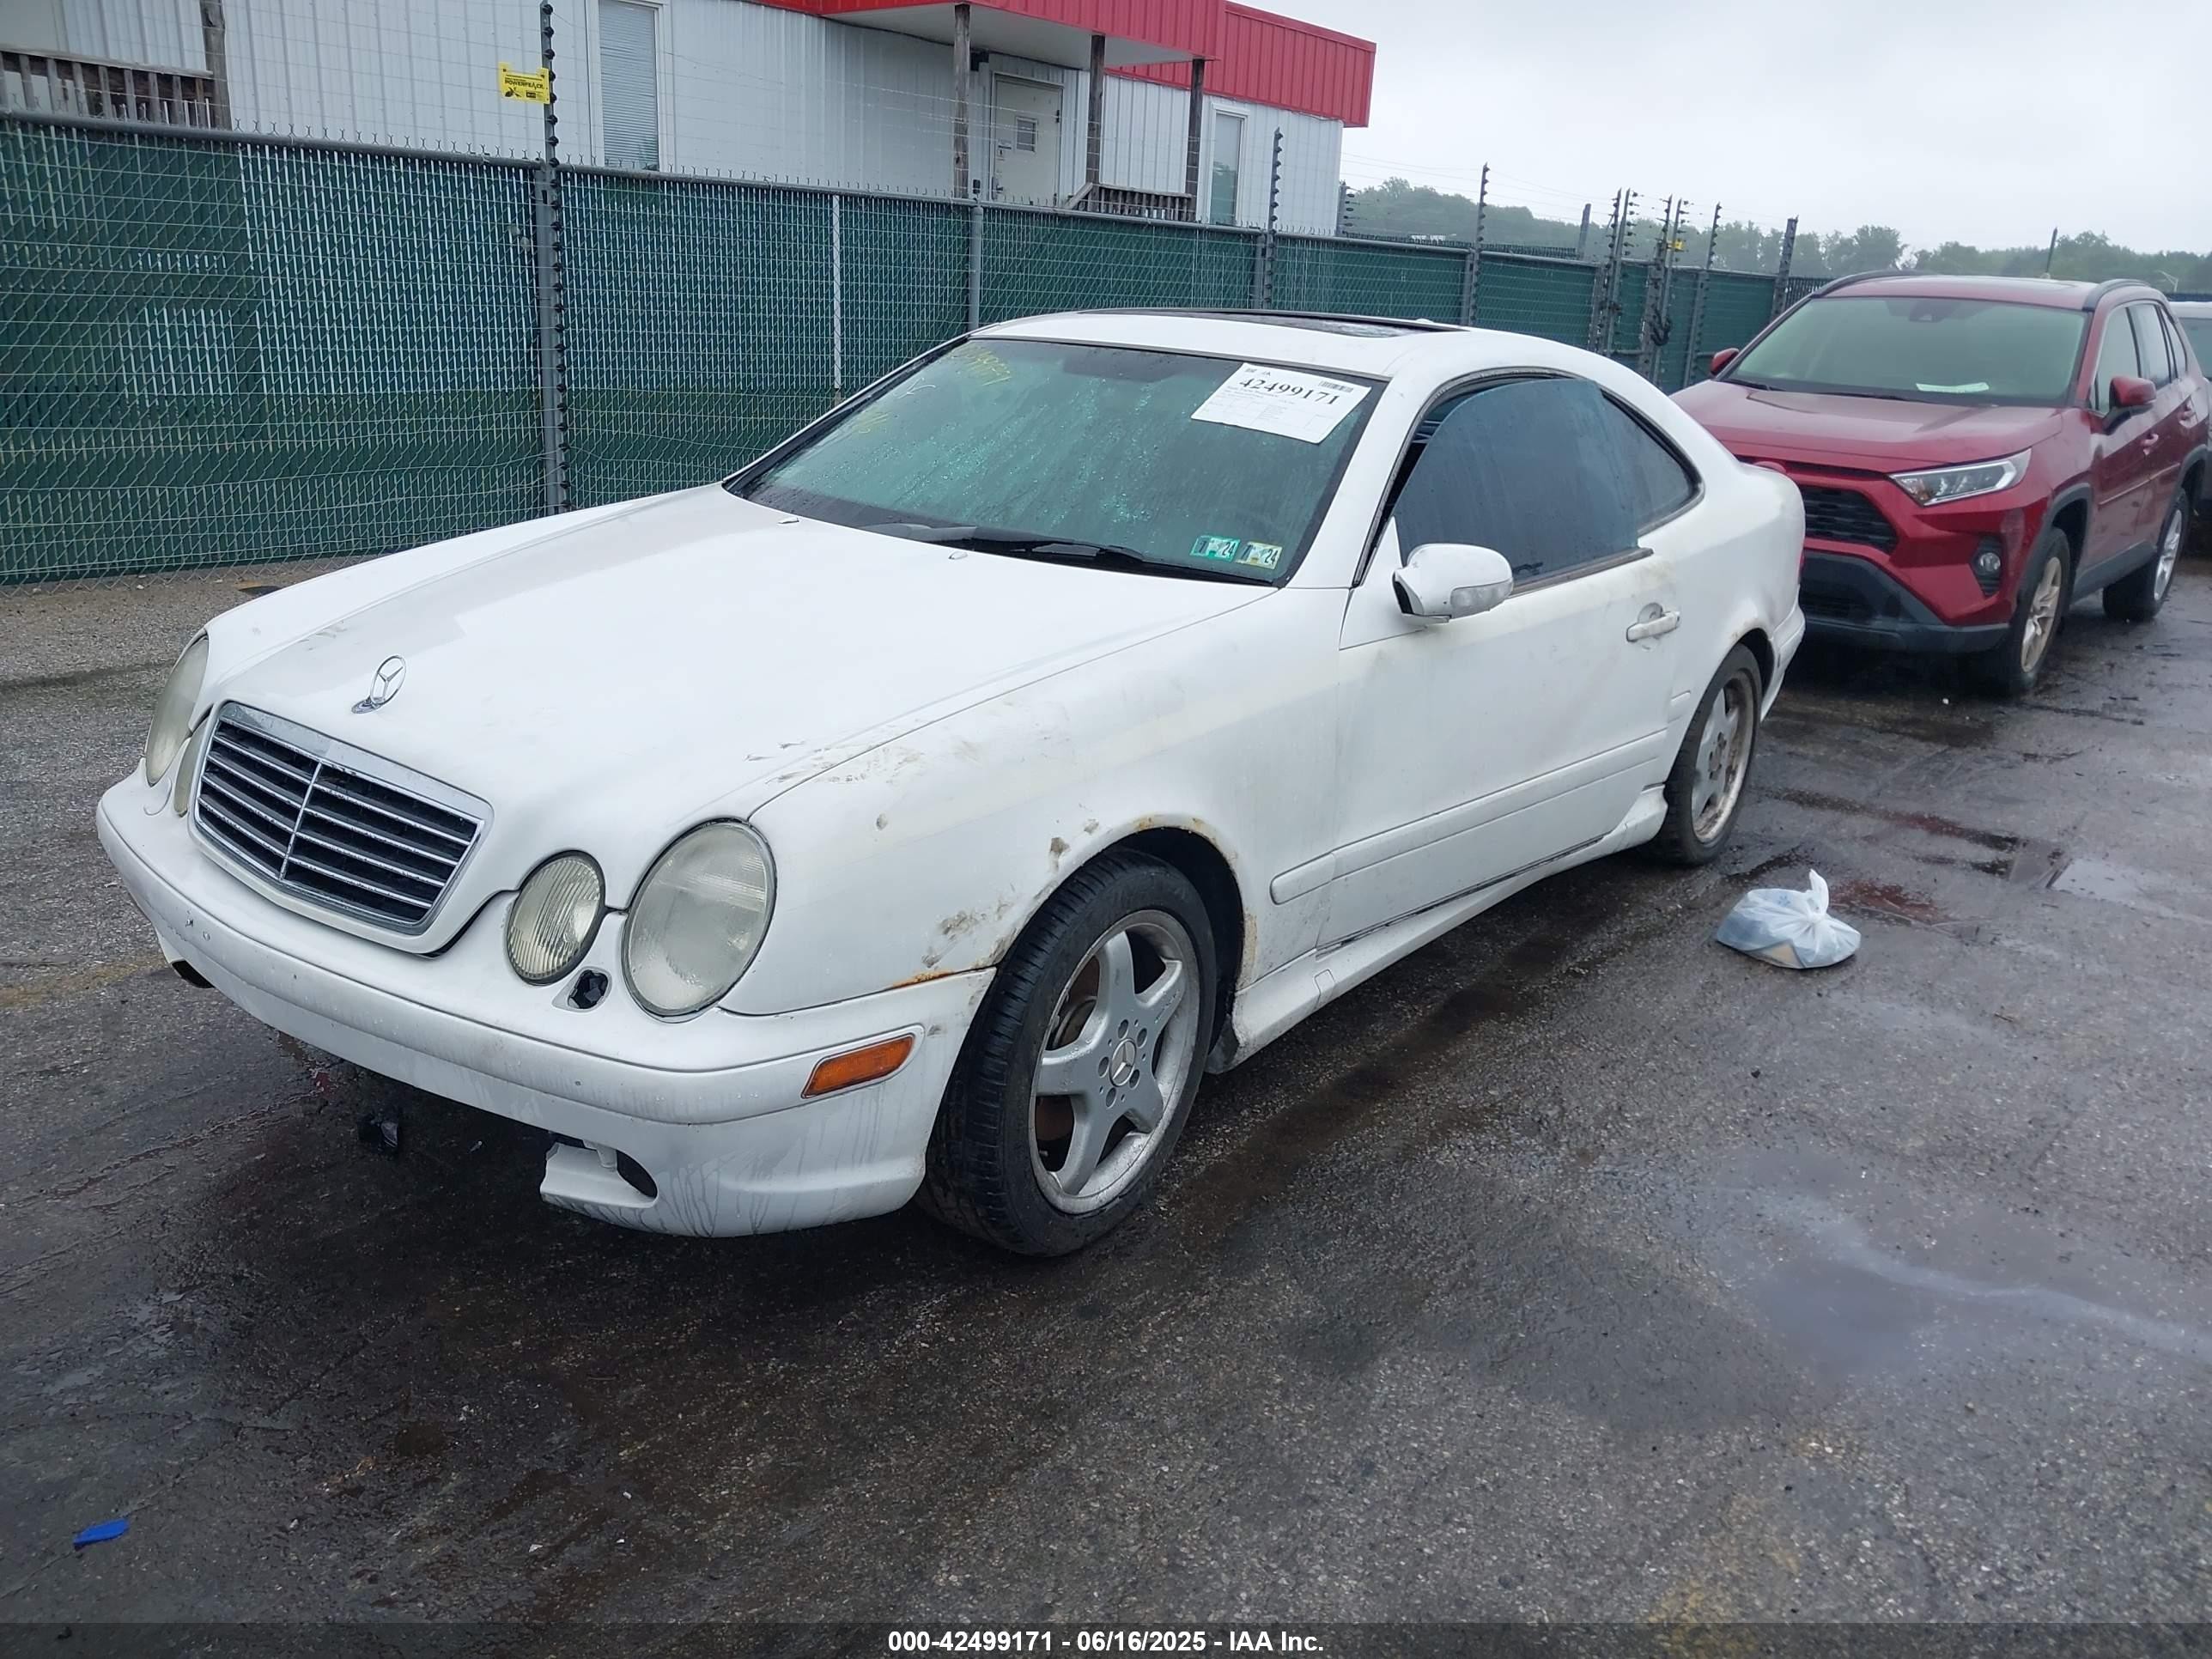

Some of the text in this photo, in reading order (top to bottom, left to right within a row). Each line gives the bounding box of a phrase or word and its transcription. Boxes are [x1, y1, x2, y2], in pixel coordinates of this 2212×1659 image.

[1239, 378, 1340, 404] 42499171
[1222, 542, 1236, 556] 24
[1264, 549, 1278, 563] 24
